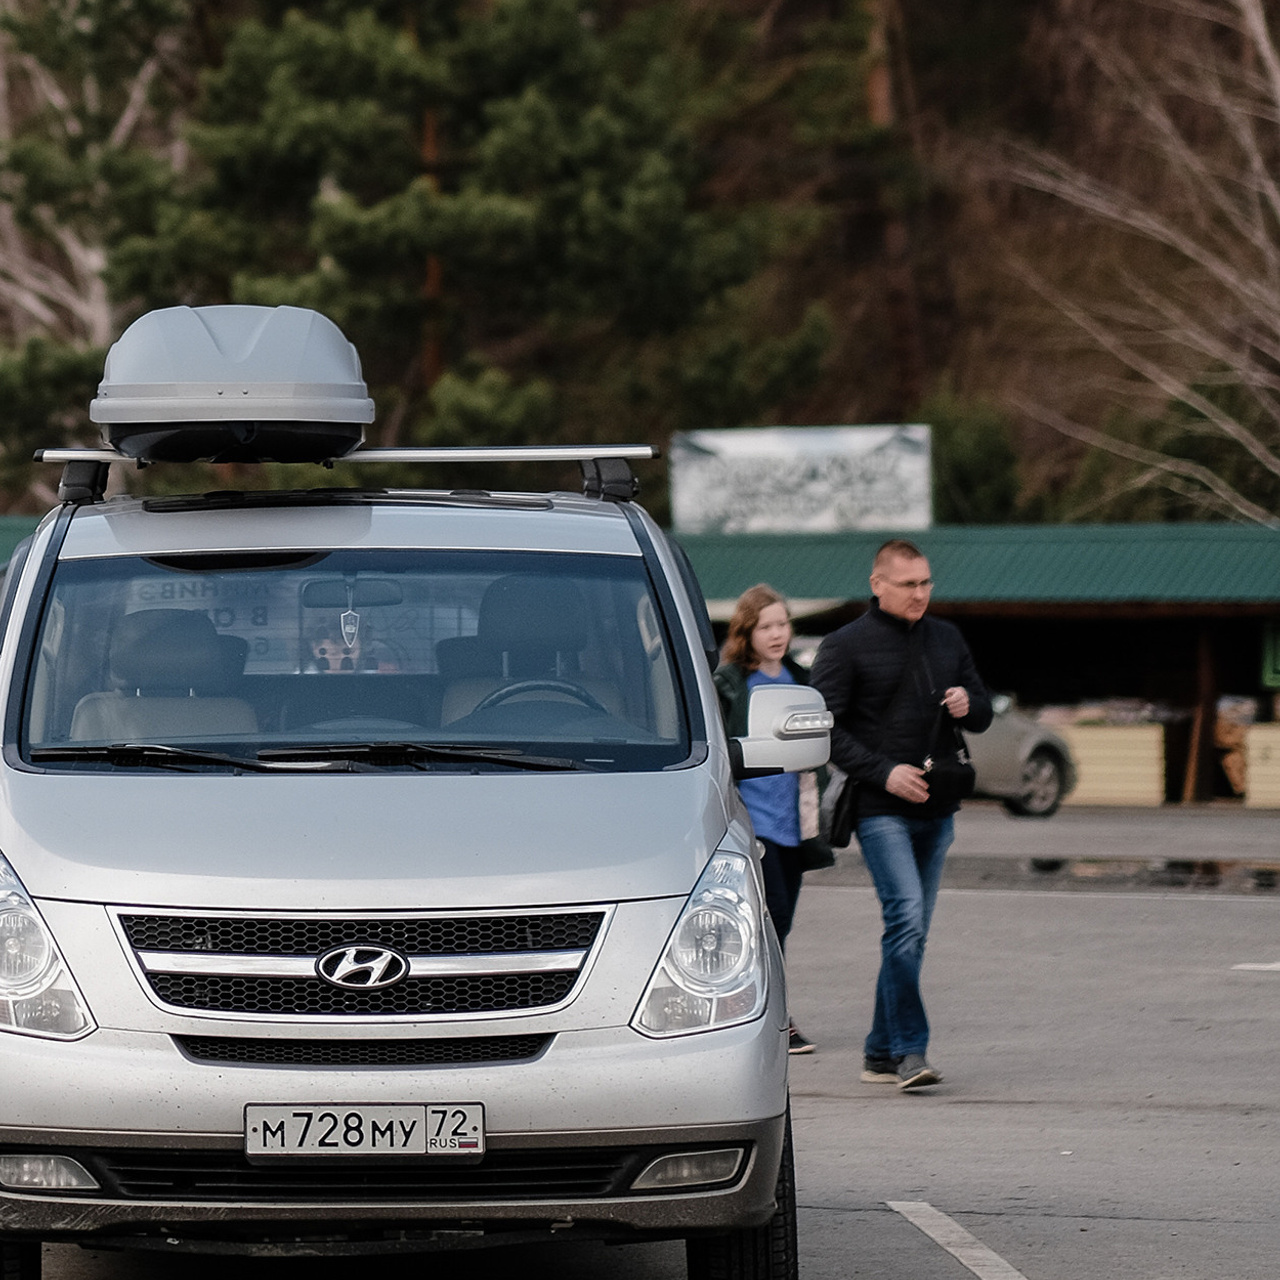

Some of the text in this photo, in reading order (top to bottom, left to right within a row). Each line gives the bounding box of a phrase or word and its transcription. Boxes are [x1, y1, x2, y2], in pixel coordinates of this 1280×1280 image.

[262, 1109, 468, 1147] М728МУ 72
[429, 1138, 458, 1149] RUS
